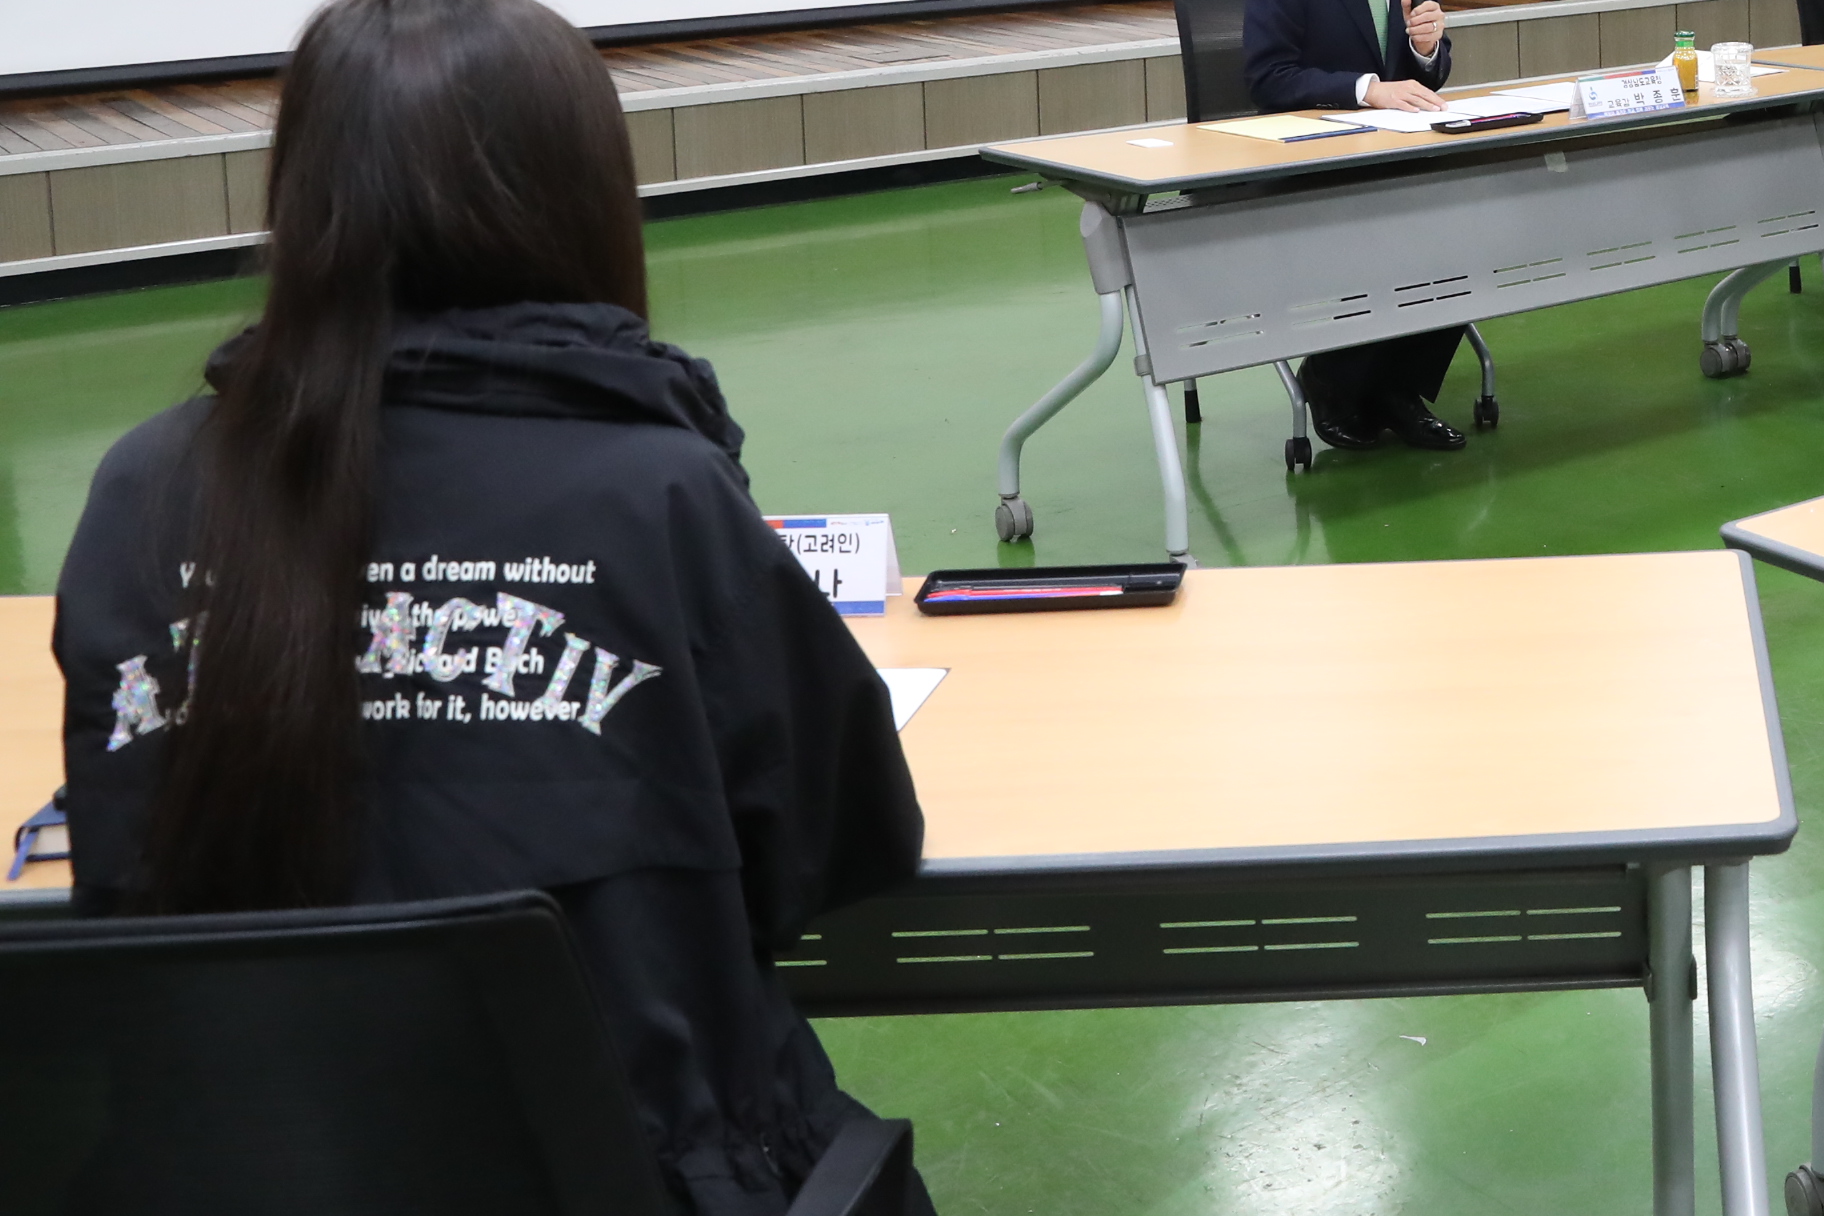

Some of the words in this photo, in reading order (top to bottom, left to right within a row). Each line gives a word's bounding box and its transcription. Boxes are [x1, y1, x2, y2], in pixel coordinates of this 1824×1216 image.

[1607, 98, 1630, 109] 교육감
[1633, 92, 1645, 105] 박
[1652, 89, 1664, 104] 종
[1670, 87, 1682, 102] 훈
[400, 563, 416, 582] a
[422, 554, 496, 582] dream
[503, 556, 597, 584] without
[484, 646, 545, 674] Bch
[416, 691, 442, 721] for
